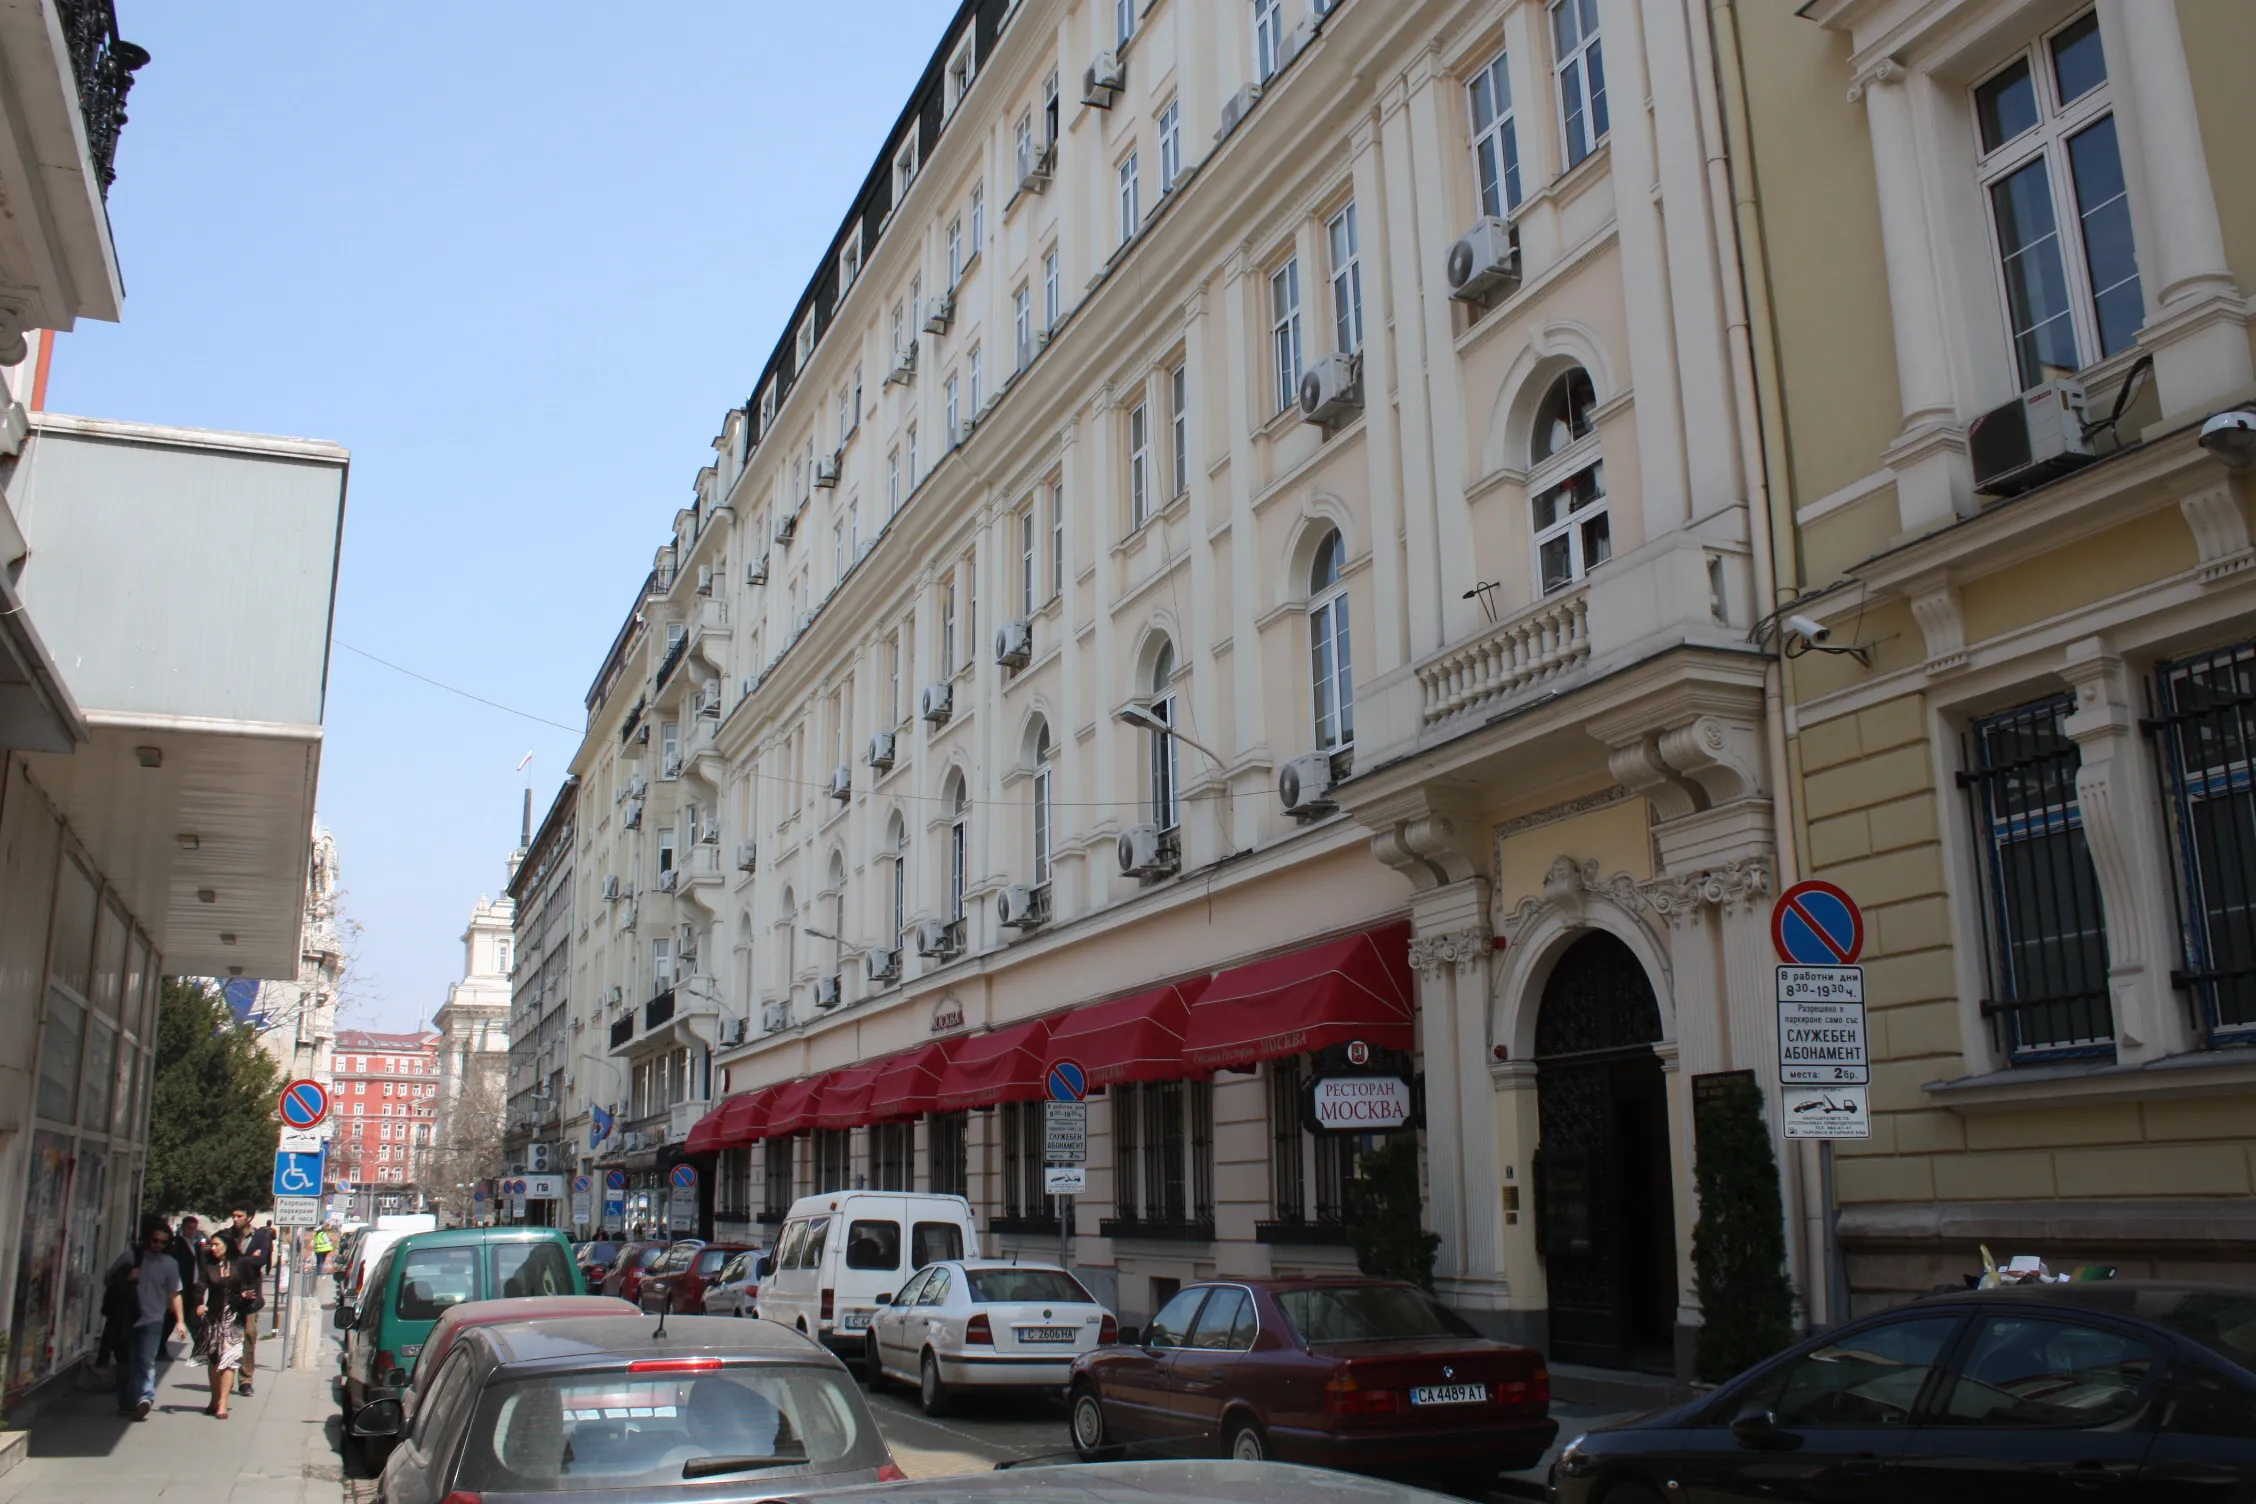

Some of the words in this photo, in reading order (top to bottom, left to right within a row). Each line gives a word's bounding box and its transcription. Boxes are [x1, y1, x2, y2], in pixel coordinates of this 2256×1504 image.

[1781, 971, 1788, 980] В
[1793, 972, 1834, 982] работни
[1840, 974, 1858, 982] дни
[1798, 1004, 1837, 1014] Разрешено
[1784, 1016, 1822, 1025] паркиране
[1260, 1031, 1307, 1054] МОСКВА
[1787, 1029, 1857, 1043] СЛУЖЕБЕН
[1784, 1046, 1861, 1060] АБОНАМЕНТ
[1325, 1082, 1395, 1097] РЕСТОРАН
[1320, 1100, 1405, 1121] МОСКВА
[1418, 1388, 1435, 1402] CA
[1437, 1386, 1466, 1402] 4489
[1469, 1385, 1482, 1400] AT
